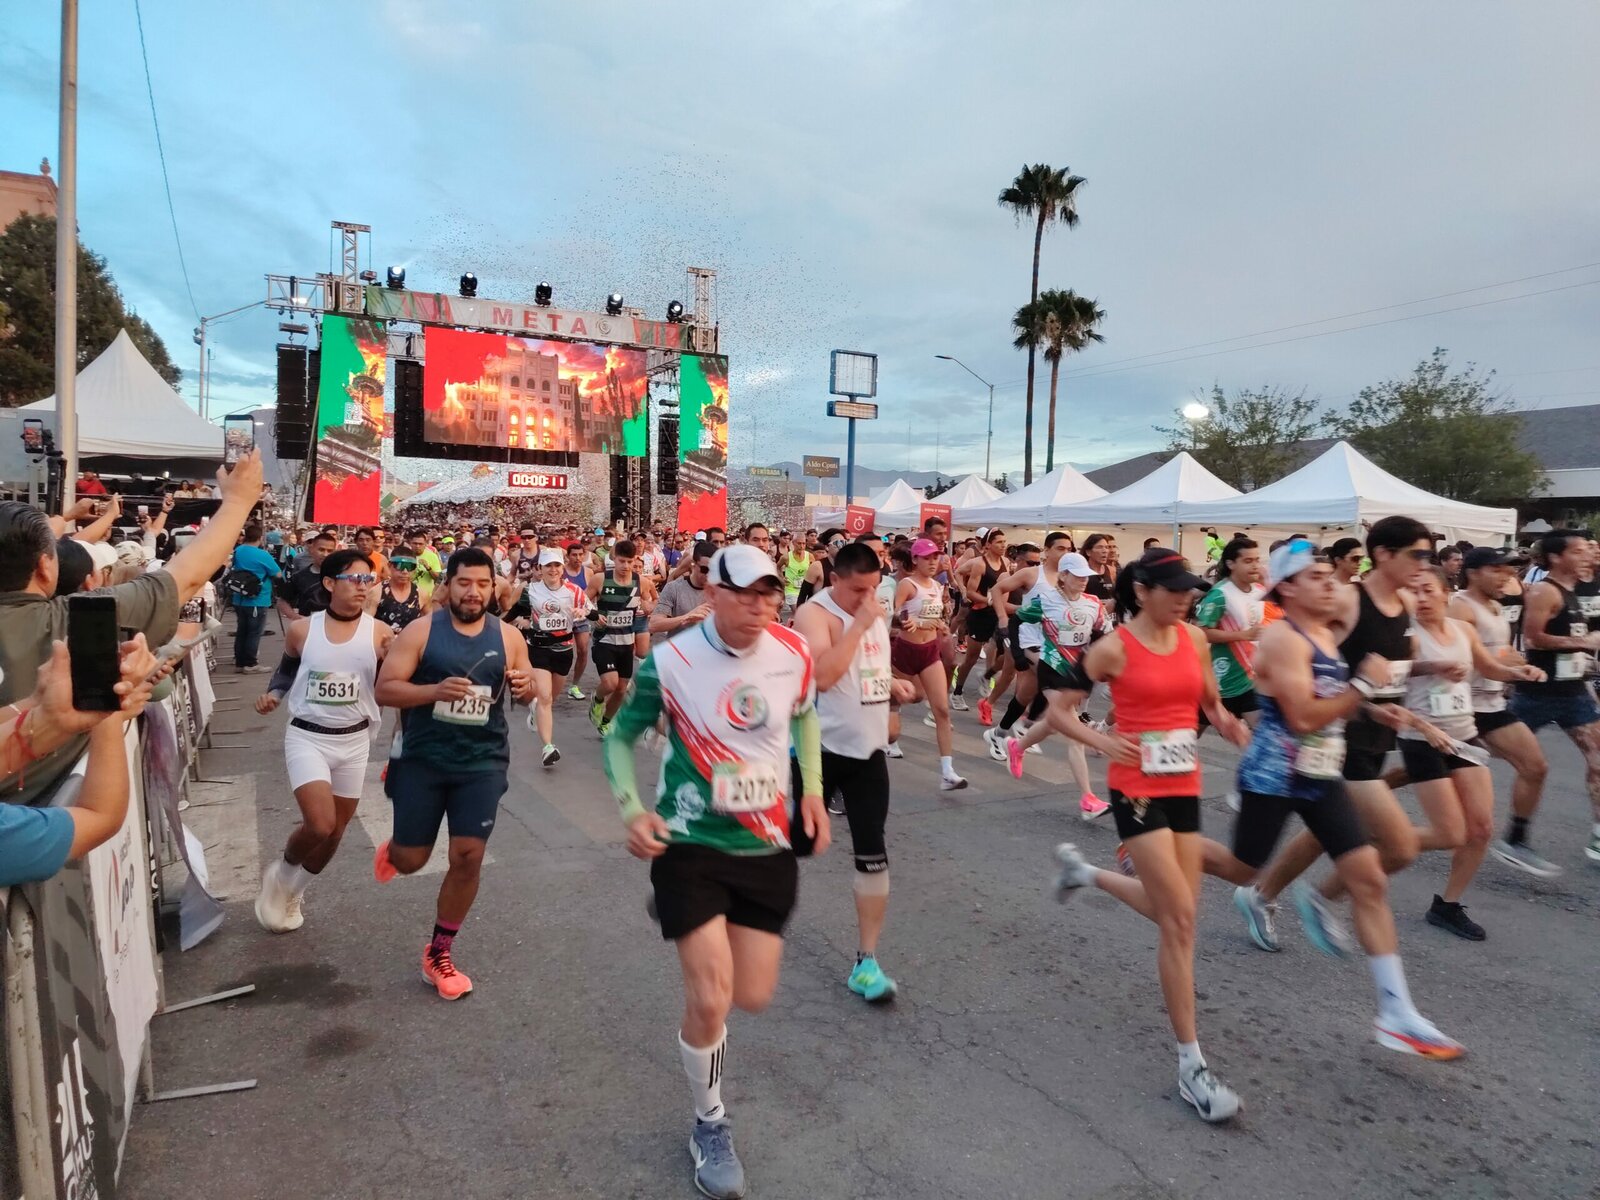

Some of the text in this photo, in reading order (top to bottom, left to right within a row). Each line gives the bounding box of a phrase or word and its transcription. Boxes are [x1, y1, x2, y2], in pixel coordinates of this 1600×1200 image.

[493, 307, 588, 335] META
[512, 473, 564, 487] 00:00:11
[546, 618, 566, 628] 6091
[613, 616, 632, 625] 4332
[1073, 632, 1084, 643] 80
[318, 682, 354, 697] 5631
[450, 698, 486, 715] 1235
